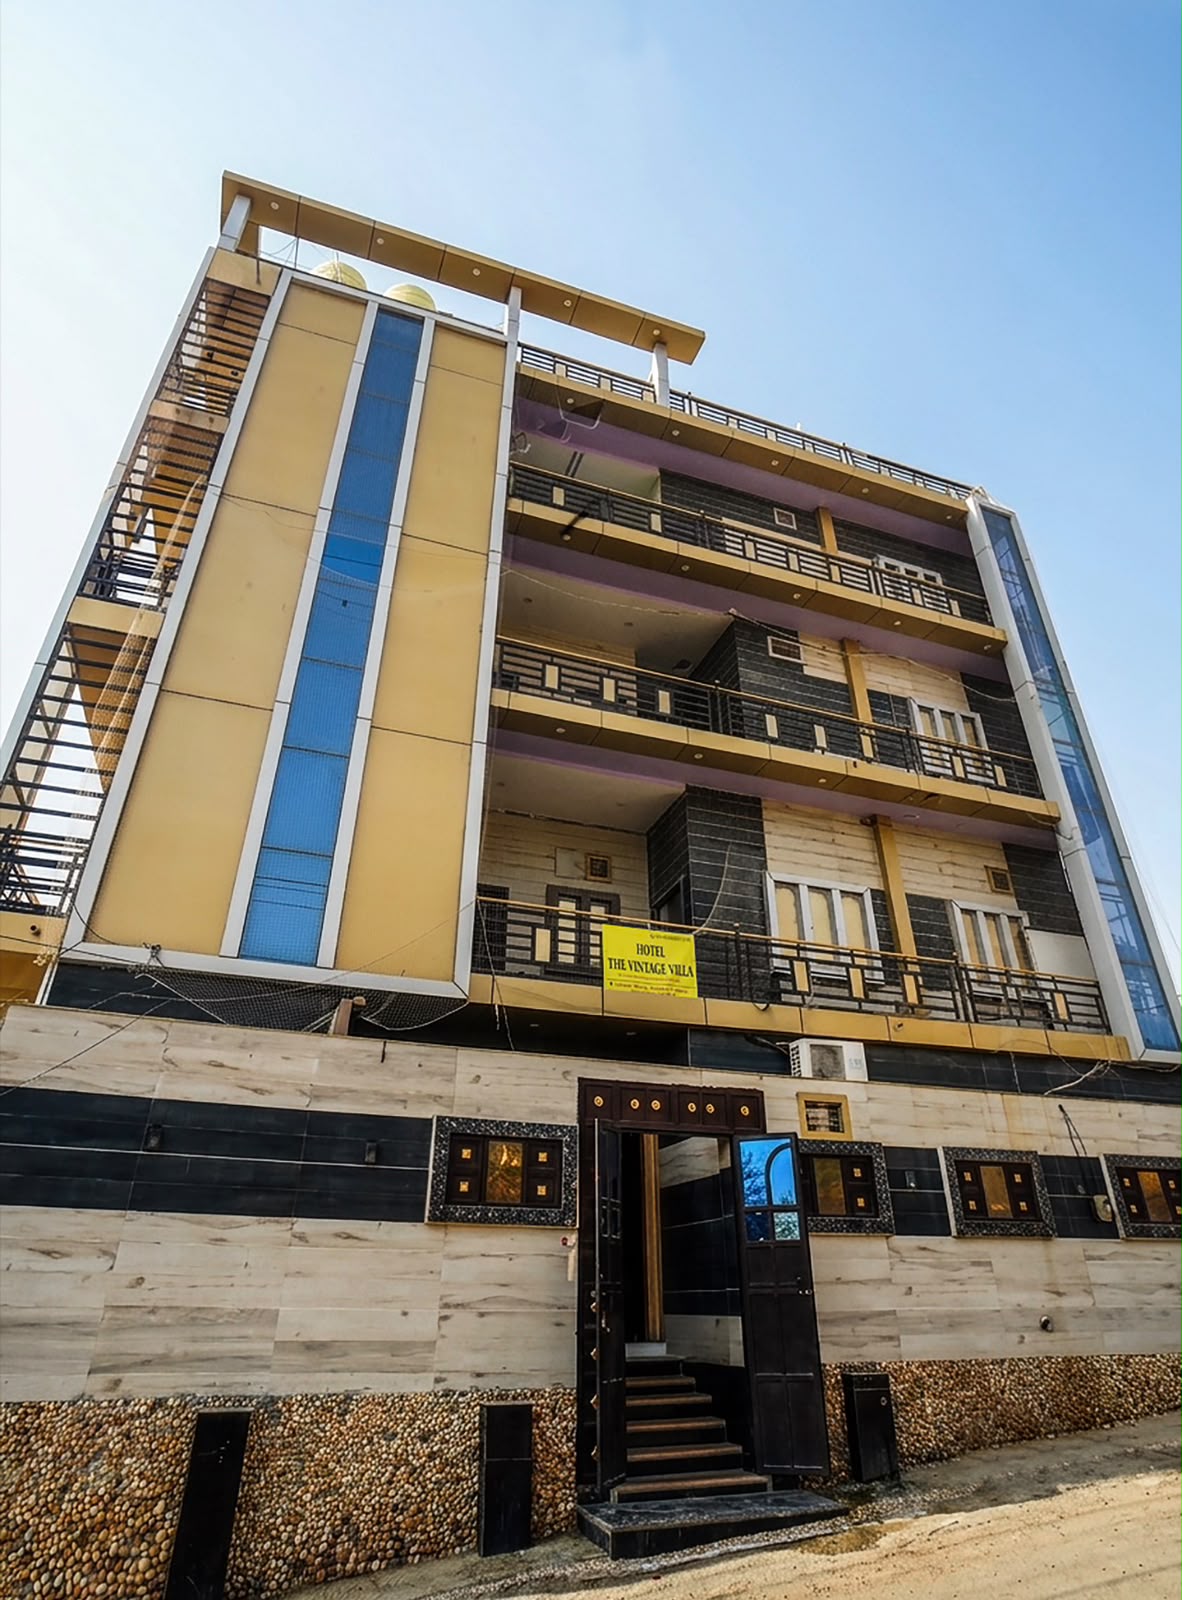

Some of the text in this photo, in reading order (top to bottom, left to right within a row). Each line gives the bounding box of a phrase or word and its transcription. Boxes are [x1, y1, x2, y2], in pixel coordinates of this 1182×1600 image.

[636, 943, 666, 958] HOTEL
[608, 957, 627, 971] THE
[628, 960, 667, 976] VINTAGE
[668, 964, 694, 978] VILLA
